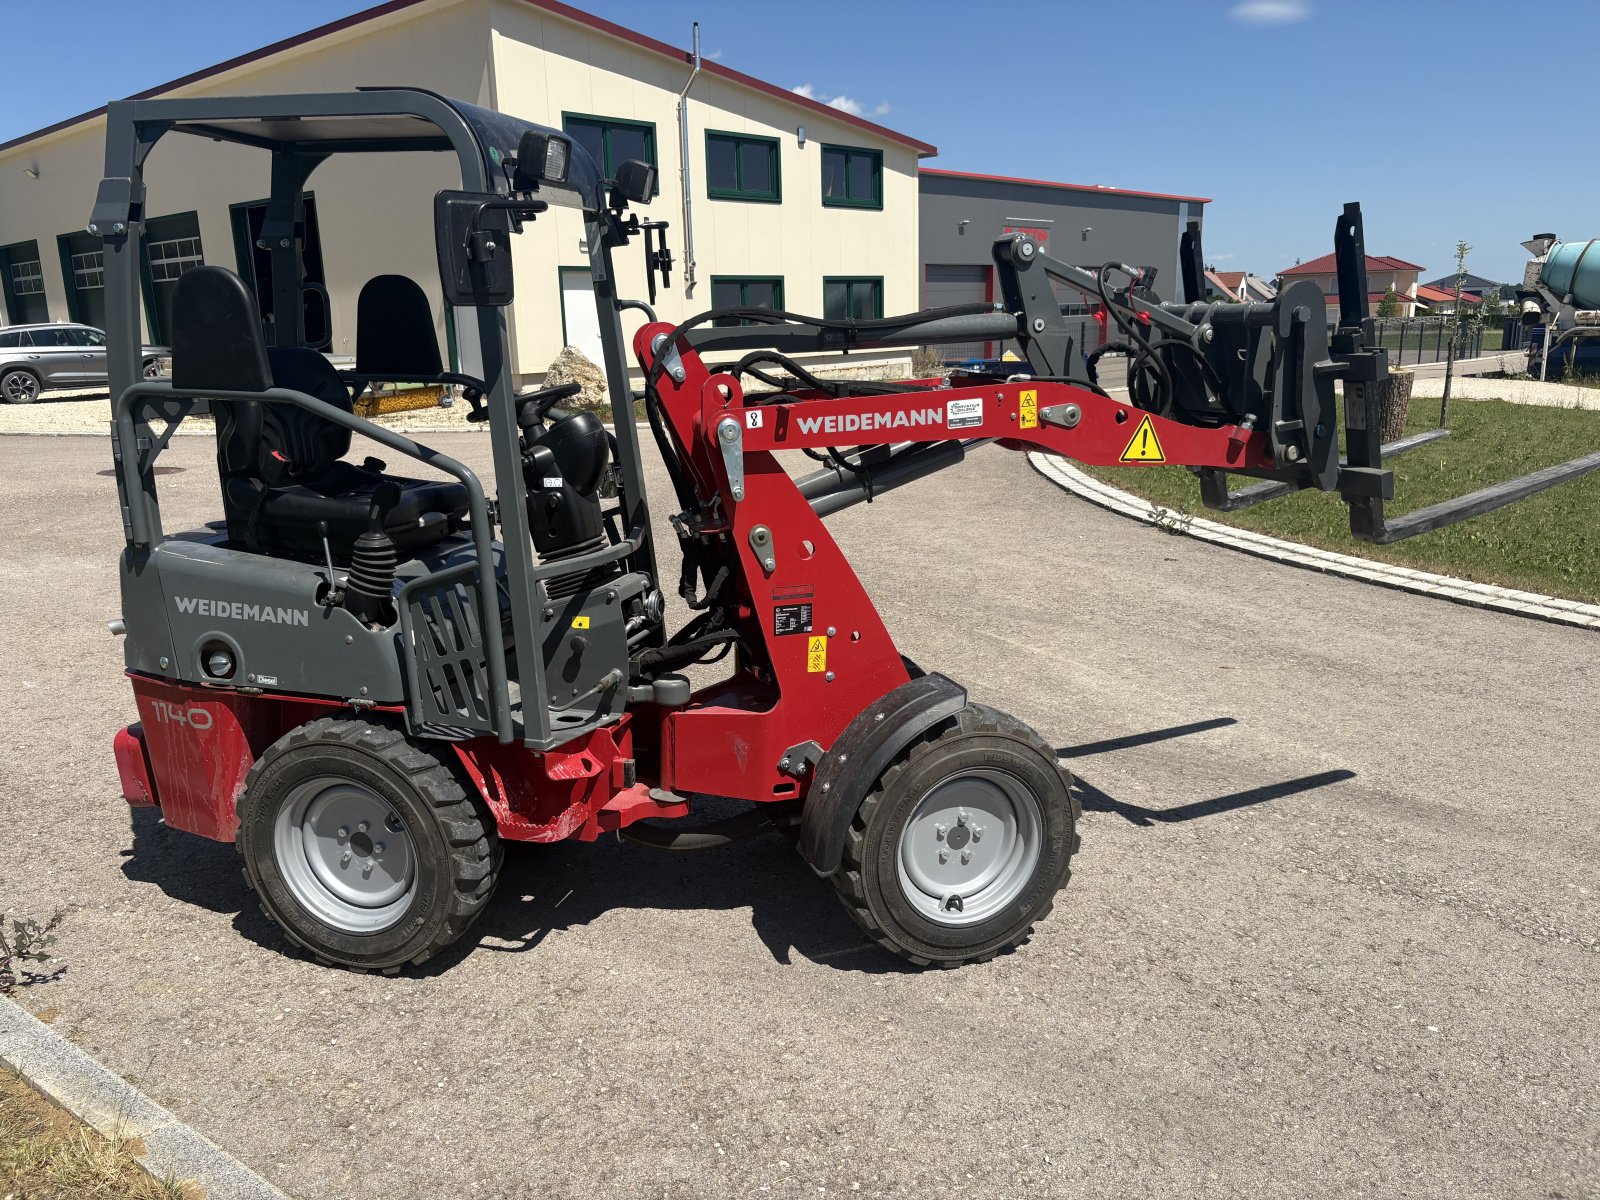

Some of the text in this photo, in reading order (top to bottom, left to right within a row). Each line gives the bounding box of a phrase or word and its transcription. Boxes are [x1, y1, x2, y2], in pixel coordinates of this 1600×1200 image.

[797, 408, 943, 435] WEIDEMANN
[174, 596, 309, 627] WEIDEMANN
[258, 676, 276, 685] Diesel
[152, 701, 213, 730] 1140
